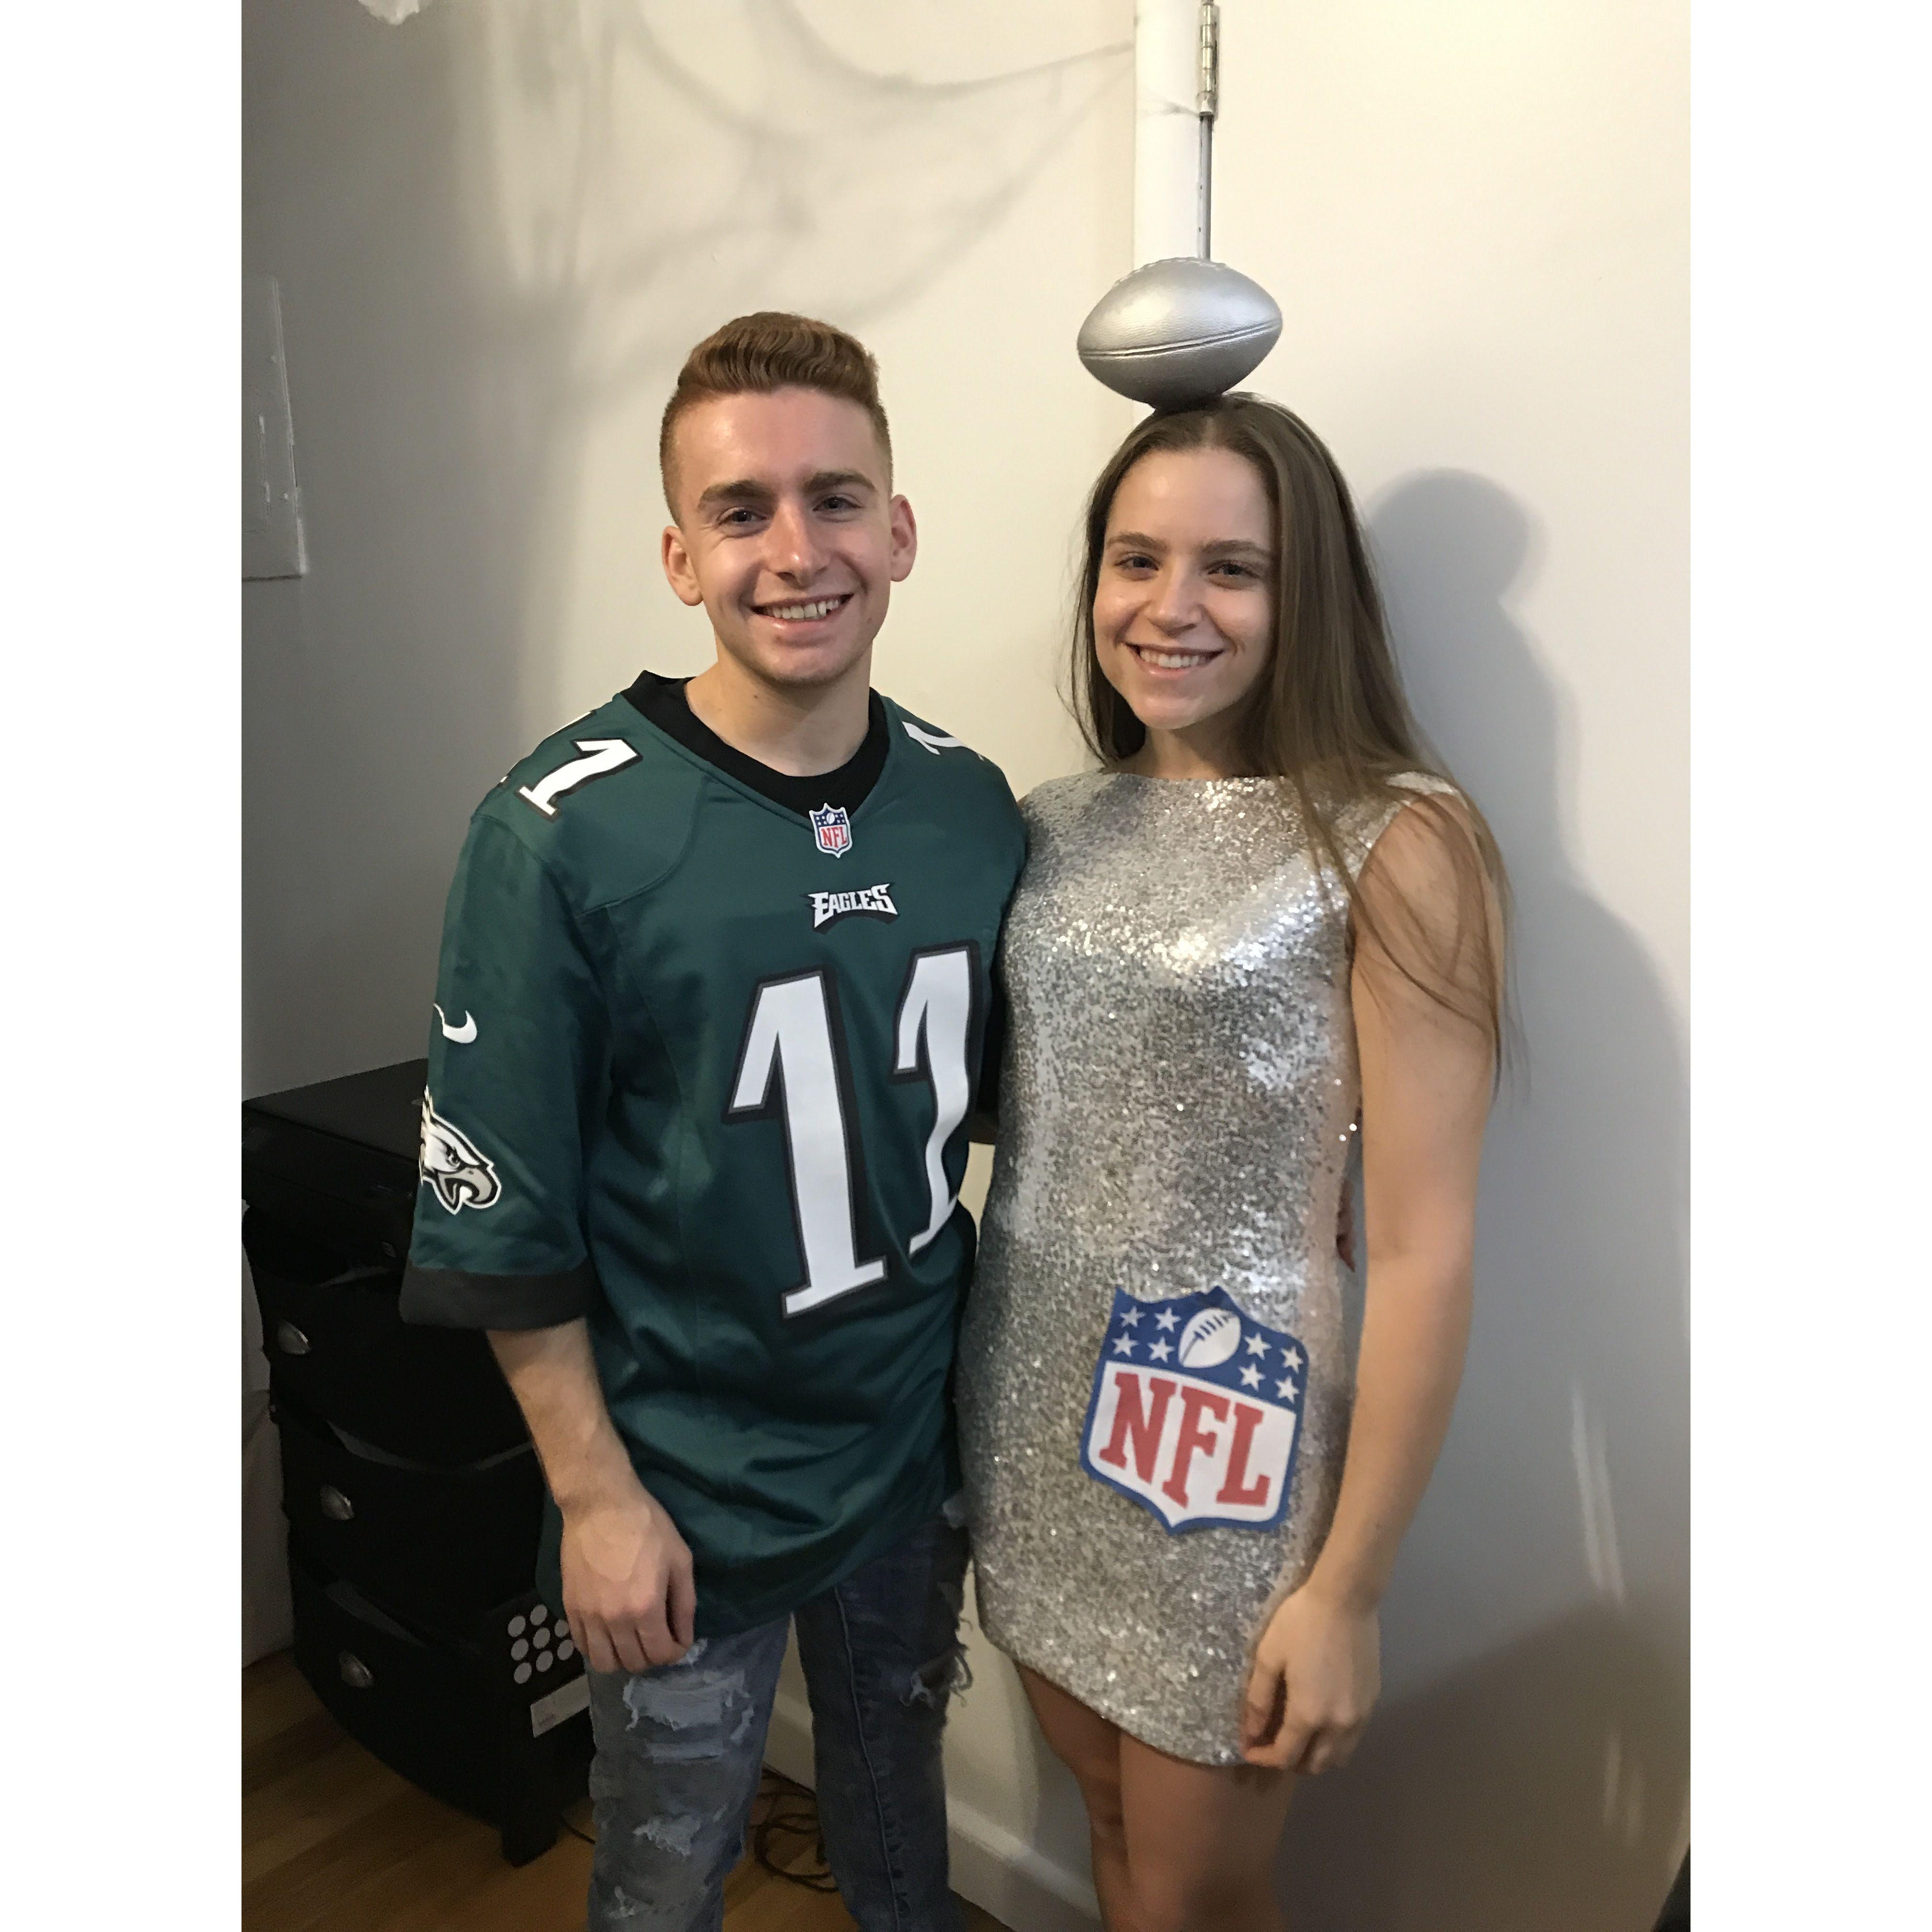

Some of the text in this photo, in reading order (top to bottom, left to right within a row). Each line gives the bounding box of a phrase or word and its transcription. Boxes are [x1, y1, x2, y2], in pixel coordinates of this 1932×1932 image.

[820, 826, 848, 848] NFL
[808, 883, 898, 928] EAGLES
[731, 948, 971, 1315] 11
[1099, 1372, 1271, 1508] NFL
